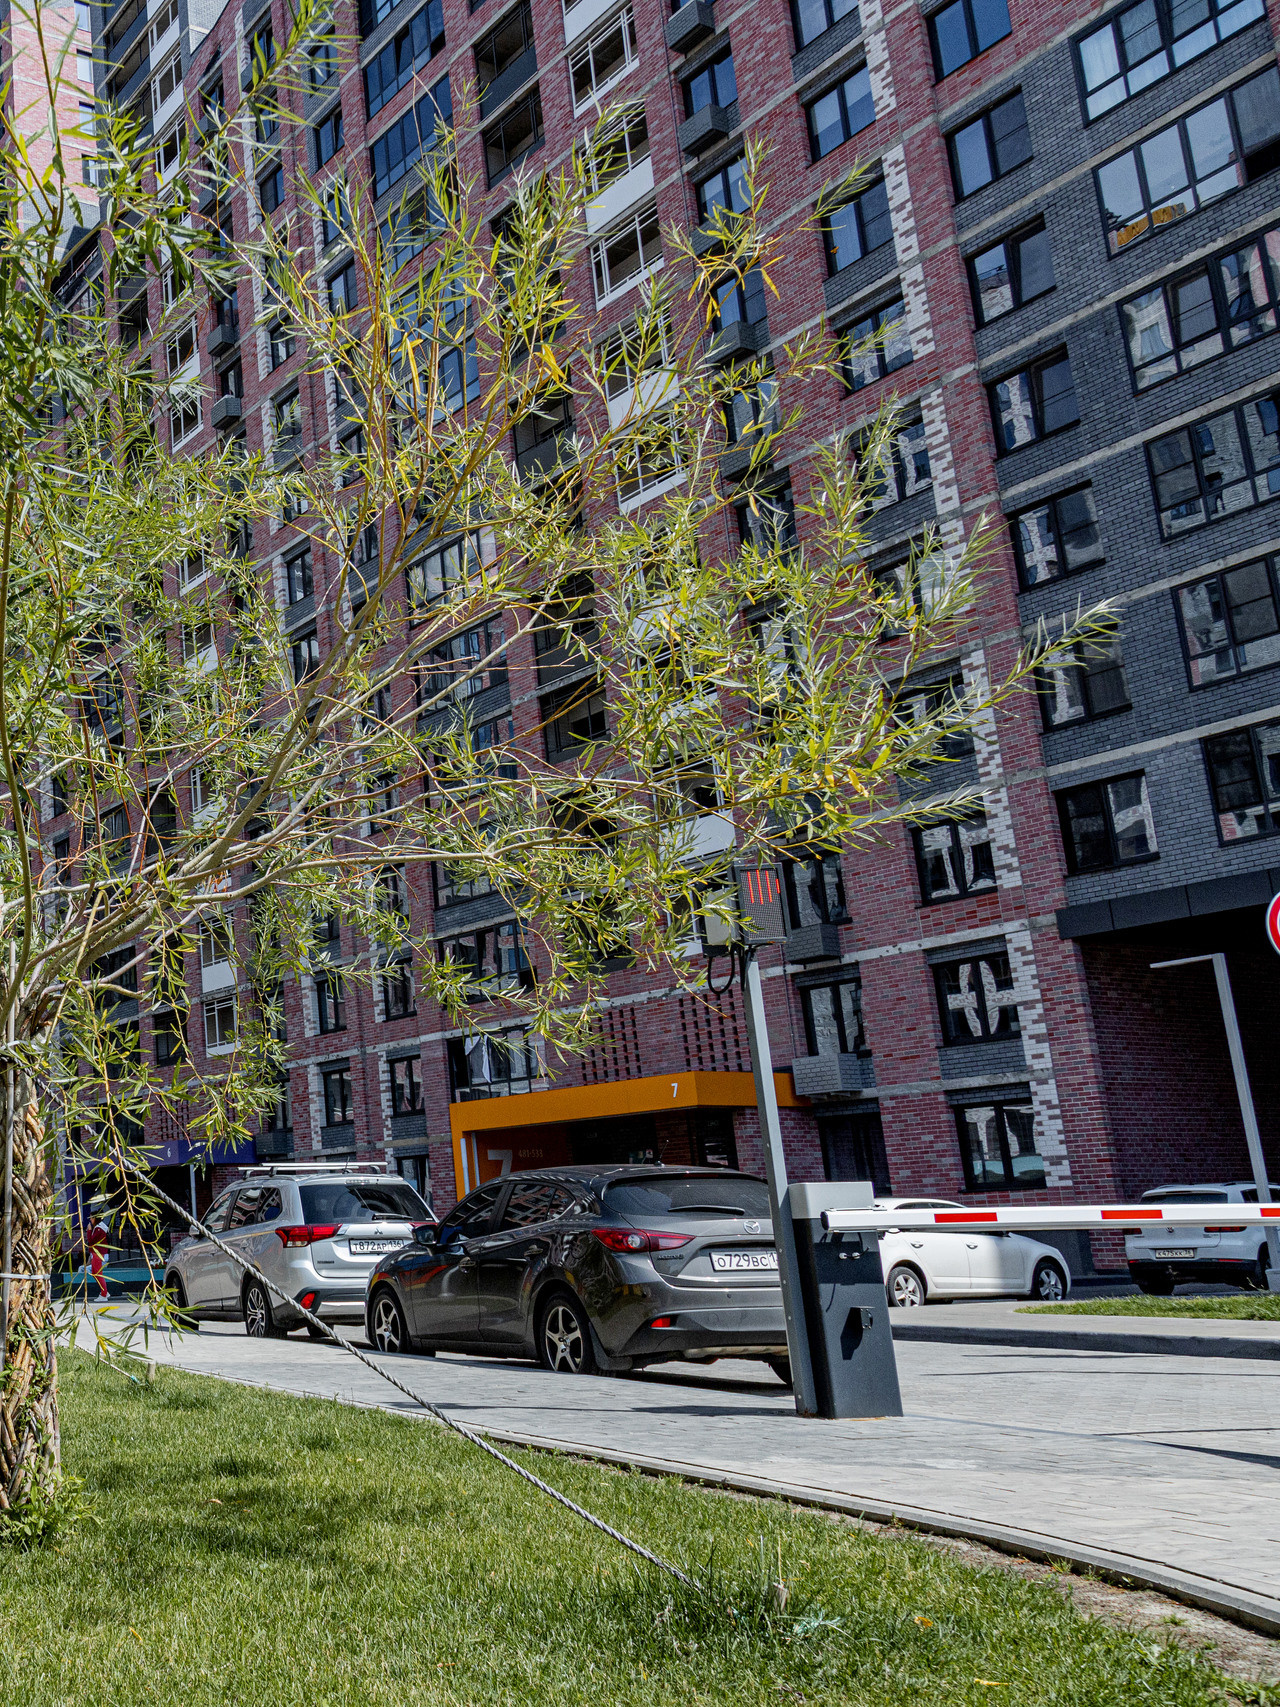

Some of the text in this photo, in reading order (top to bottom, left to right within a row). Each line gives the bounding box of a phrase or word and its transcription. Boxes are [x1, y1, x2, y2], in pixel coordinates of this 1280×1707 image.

[671, 1083, 678, 1098] 7
[167, 1147, 172, 1158] 6
[487, 1149, 513, 1176] 7
